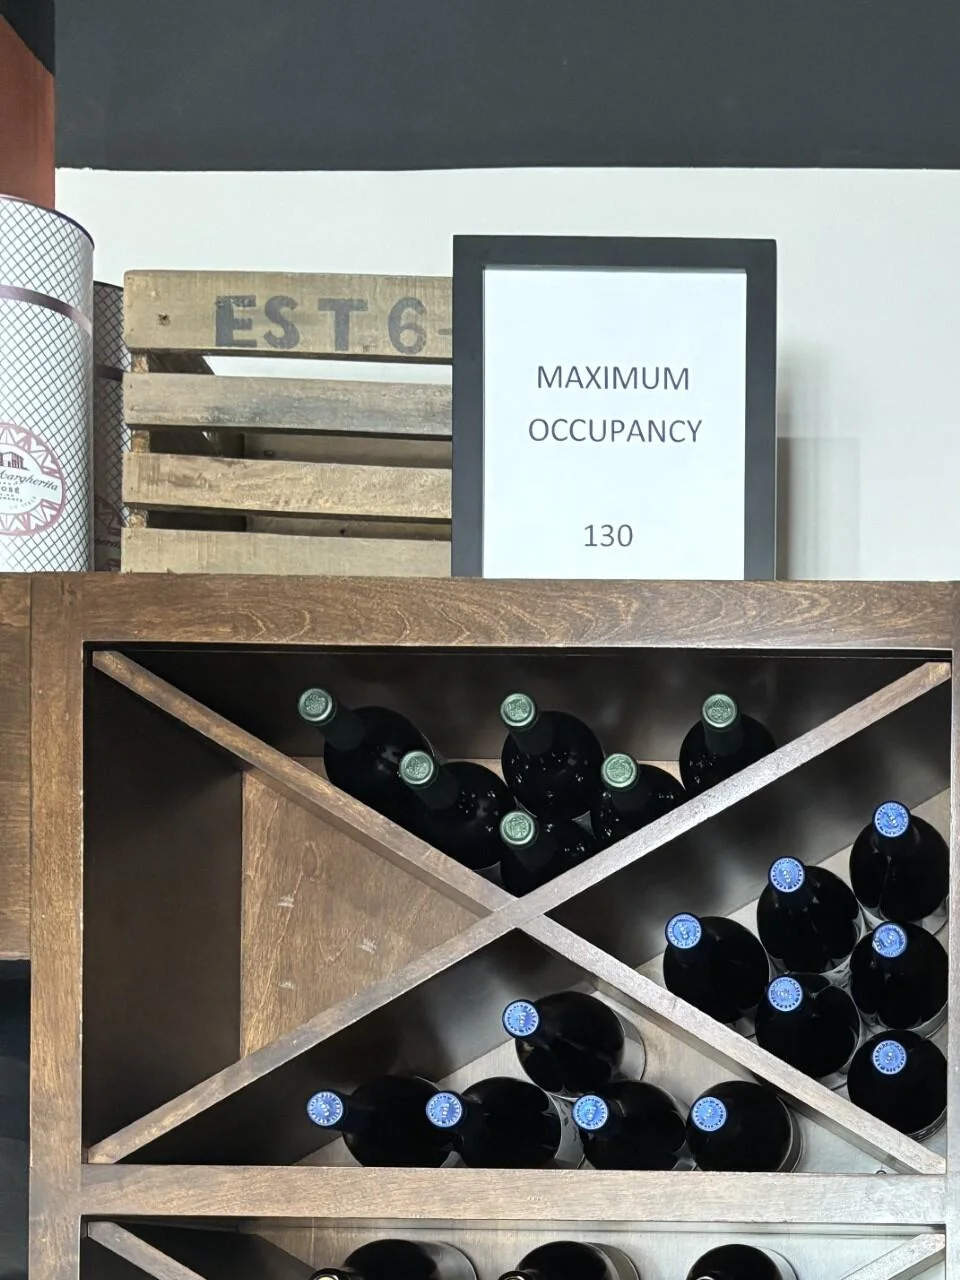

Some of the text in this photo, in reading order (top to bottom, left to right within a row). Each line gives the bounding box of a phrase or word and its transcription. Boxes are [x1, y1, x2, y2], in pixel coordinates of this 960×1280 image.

[537, 365, 689, 390] MAXIMUM
[528, 418, 702, 443] OCCUPANCY
[0, 469, 58, 492] argherita
[584, 524, 633, 547] 130
